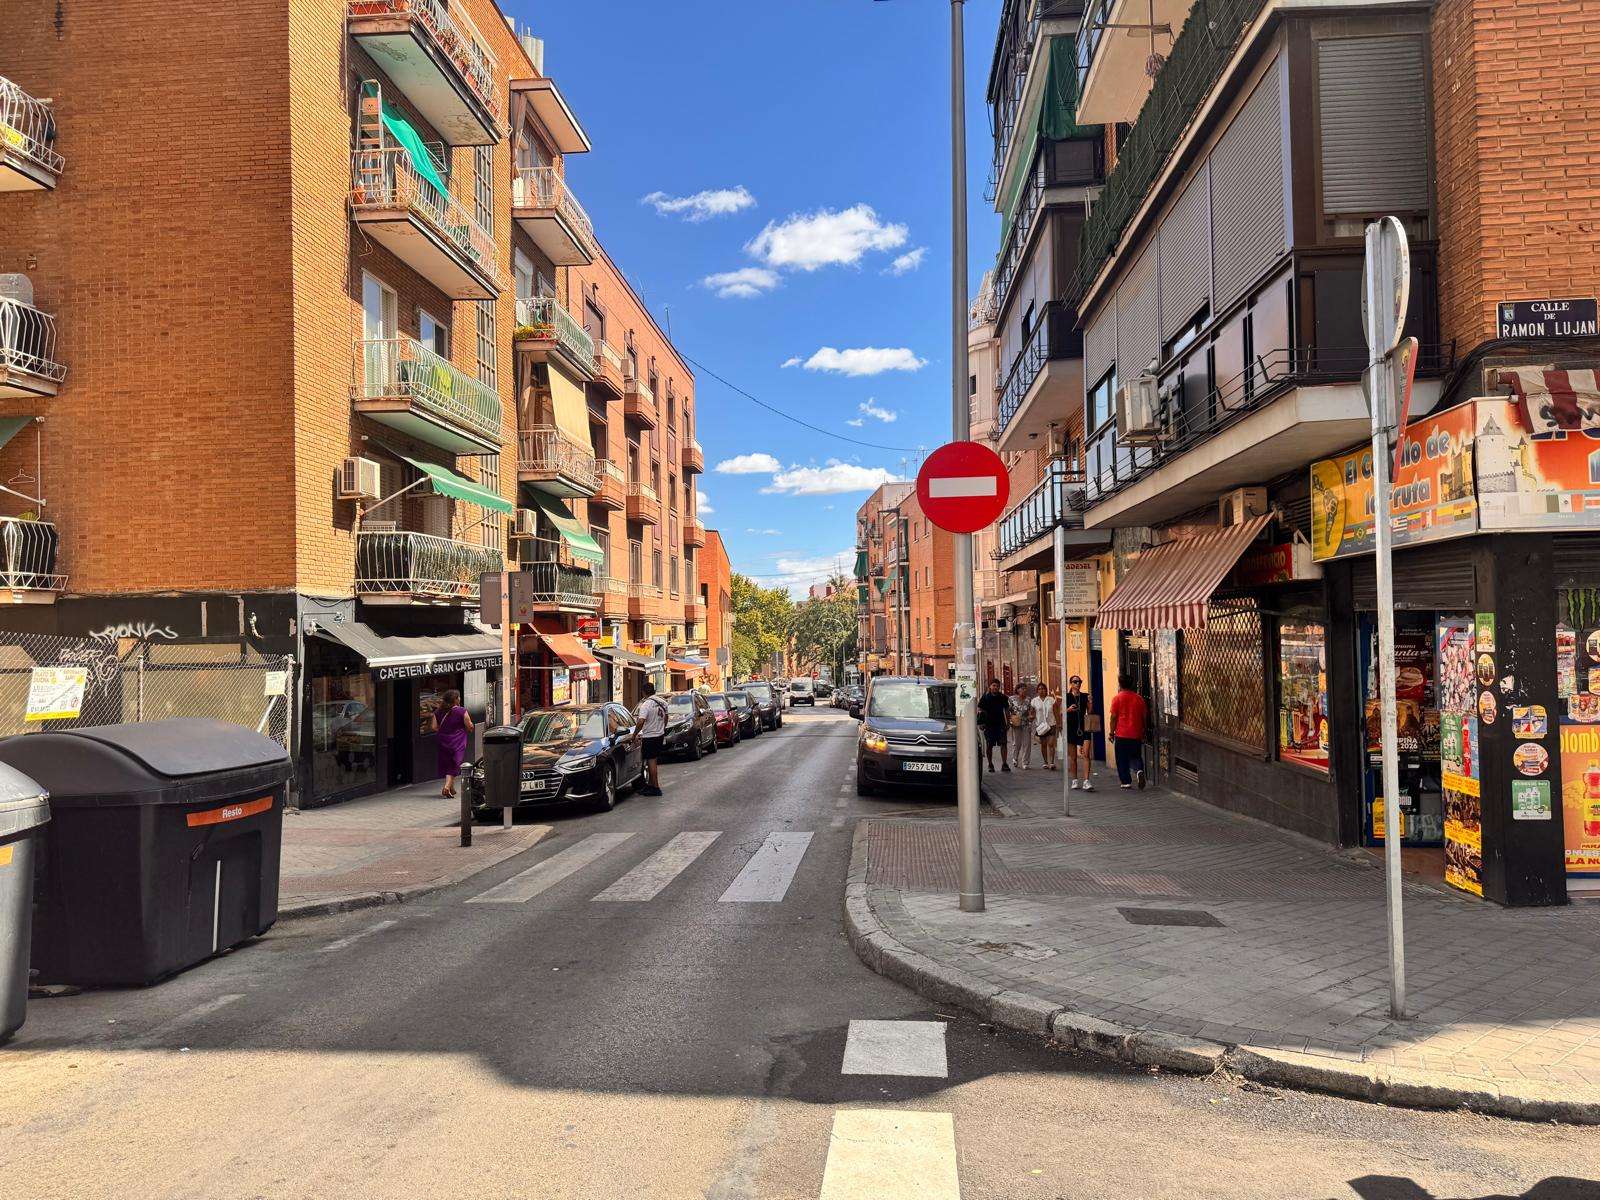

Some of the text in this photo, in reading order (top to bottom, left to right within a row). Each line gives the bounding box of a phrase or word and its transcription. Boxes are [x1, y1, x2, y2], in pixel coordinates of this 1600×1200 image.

[1530, 302, 1570, 312] CALLE
[1502, 320, 1596, 337] RAMON LUJAN
[1426, 424, 1451, 460] de
[1391, 473, 1431, 510] ruta
[380, 664, 432, 680] CAFETERIA
[433, 661, 454, 674] GRAN
[455, 660, 472, 672] CAFE
[1560, 727, 1600, 753] lomb
[926, 763, 940, 771] LGN
[222, 807, 243, 819] Resto
